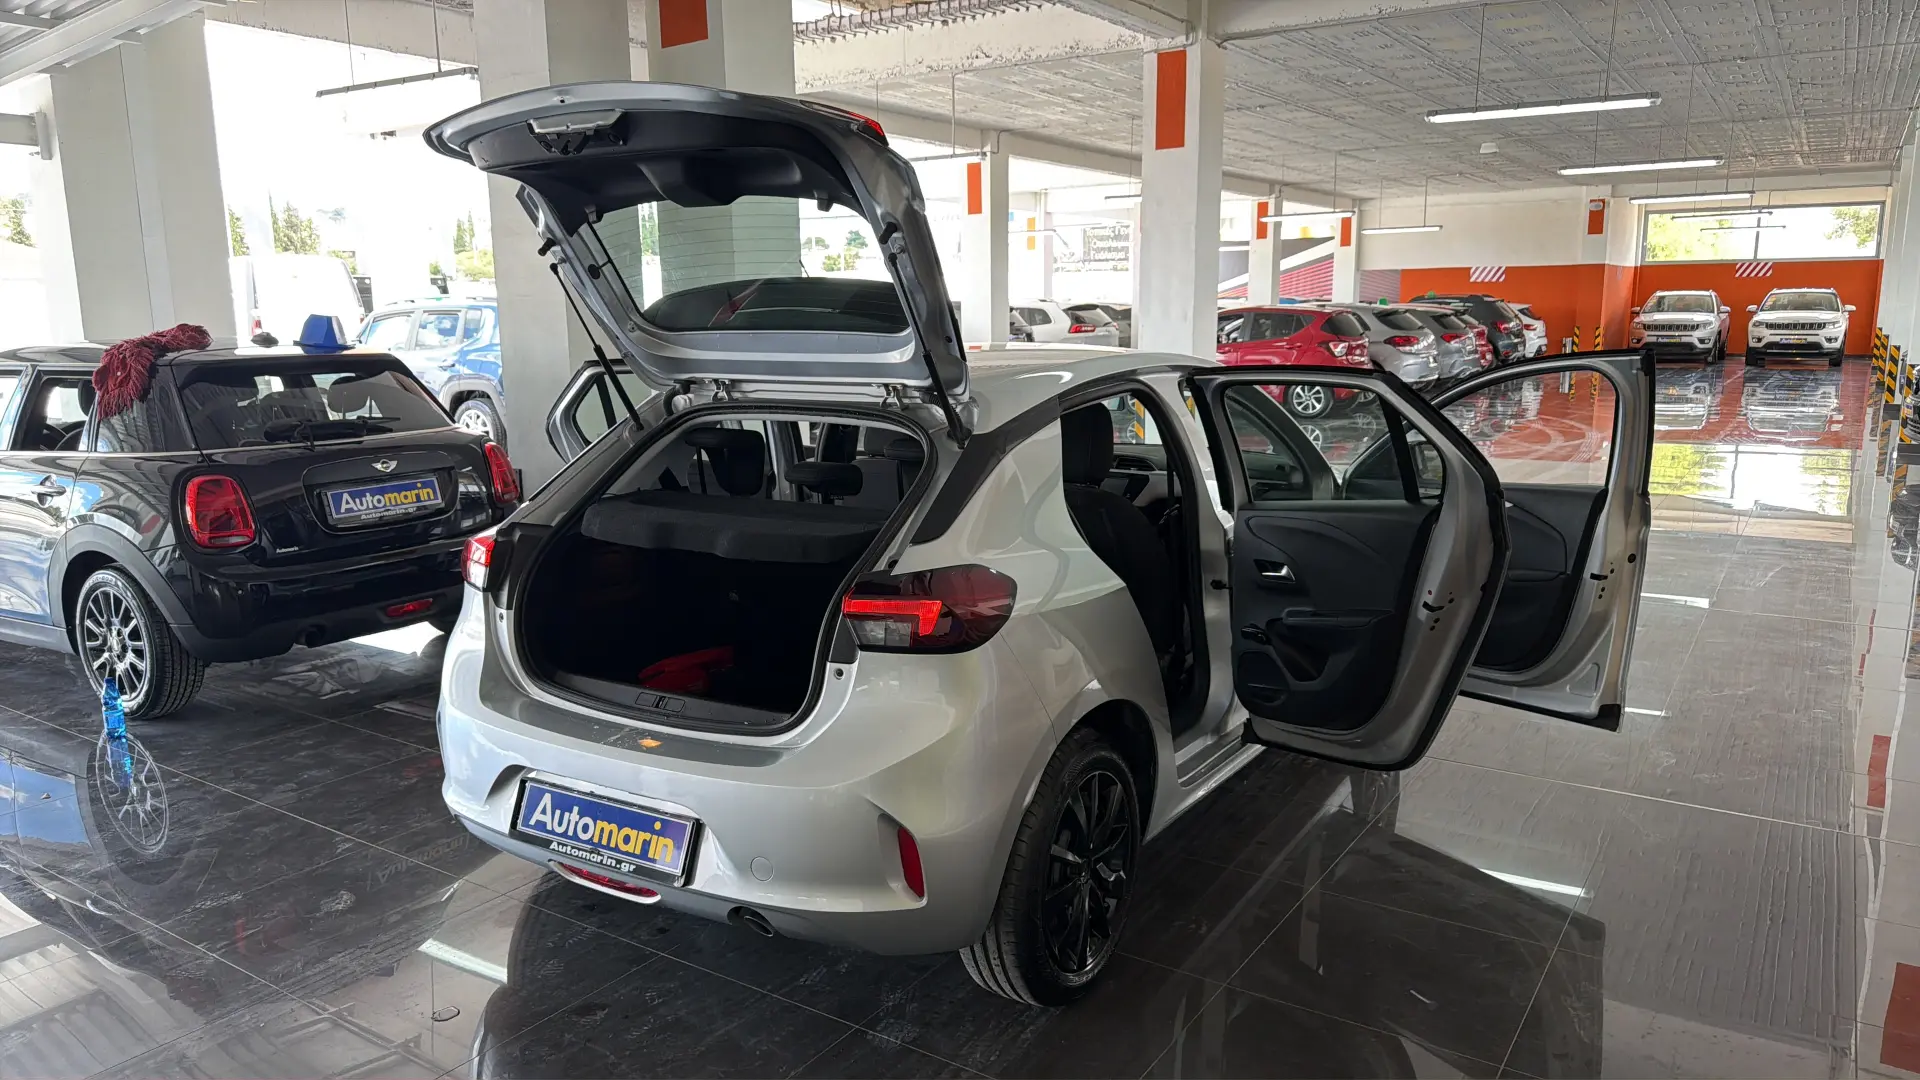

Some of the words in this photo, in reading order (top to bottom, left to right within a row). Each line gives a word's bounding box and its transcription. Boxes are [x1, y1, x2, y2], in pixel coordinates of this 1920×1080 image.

[340, 482, 434, 513] Automarin
[361, 507, 417, 520] Automarin.gr
[529, 792, 674, 863] Automarin
[549, 841, 636, 872] Automarin.gr
